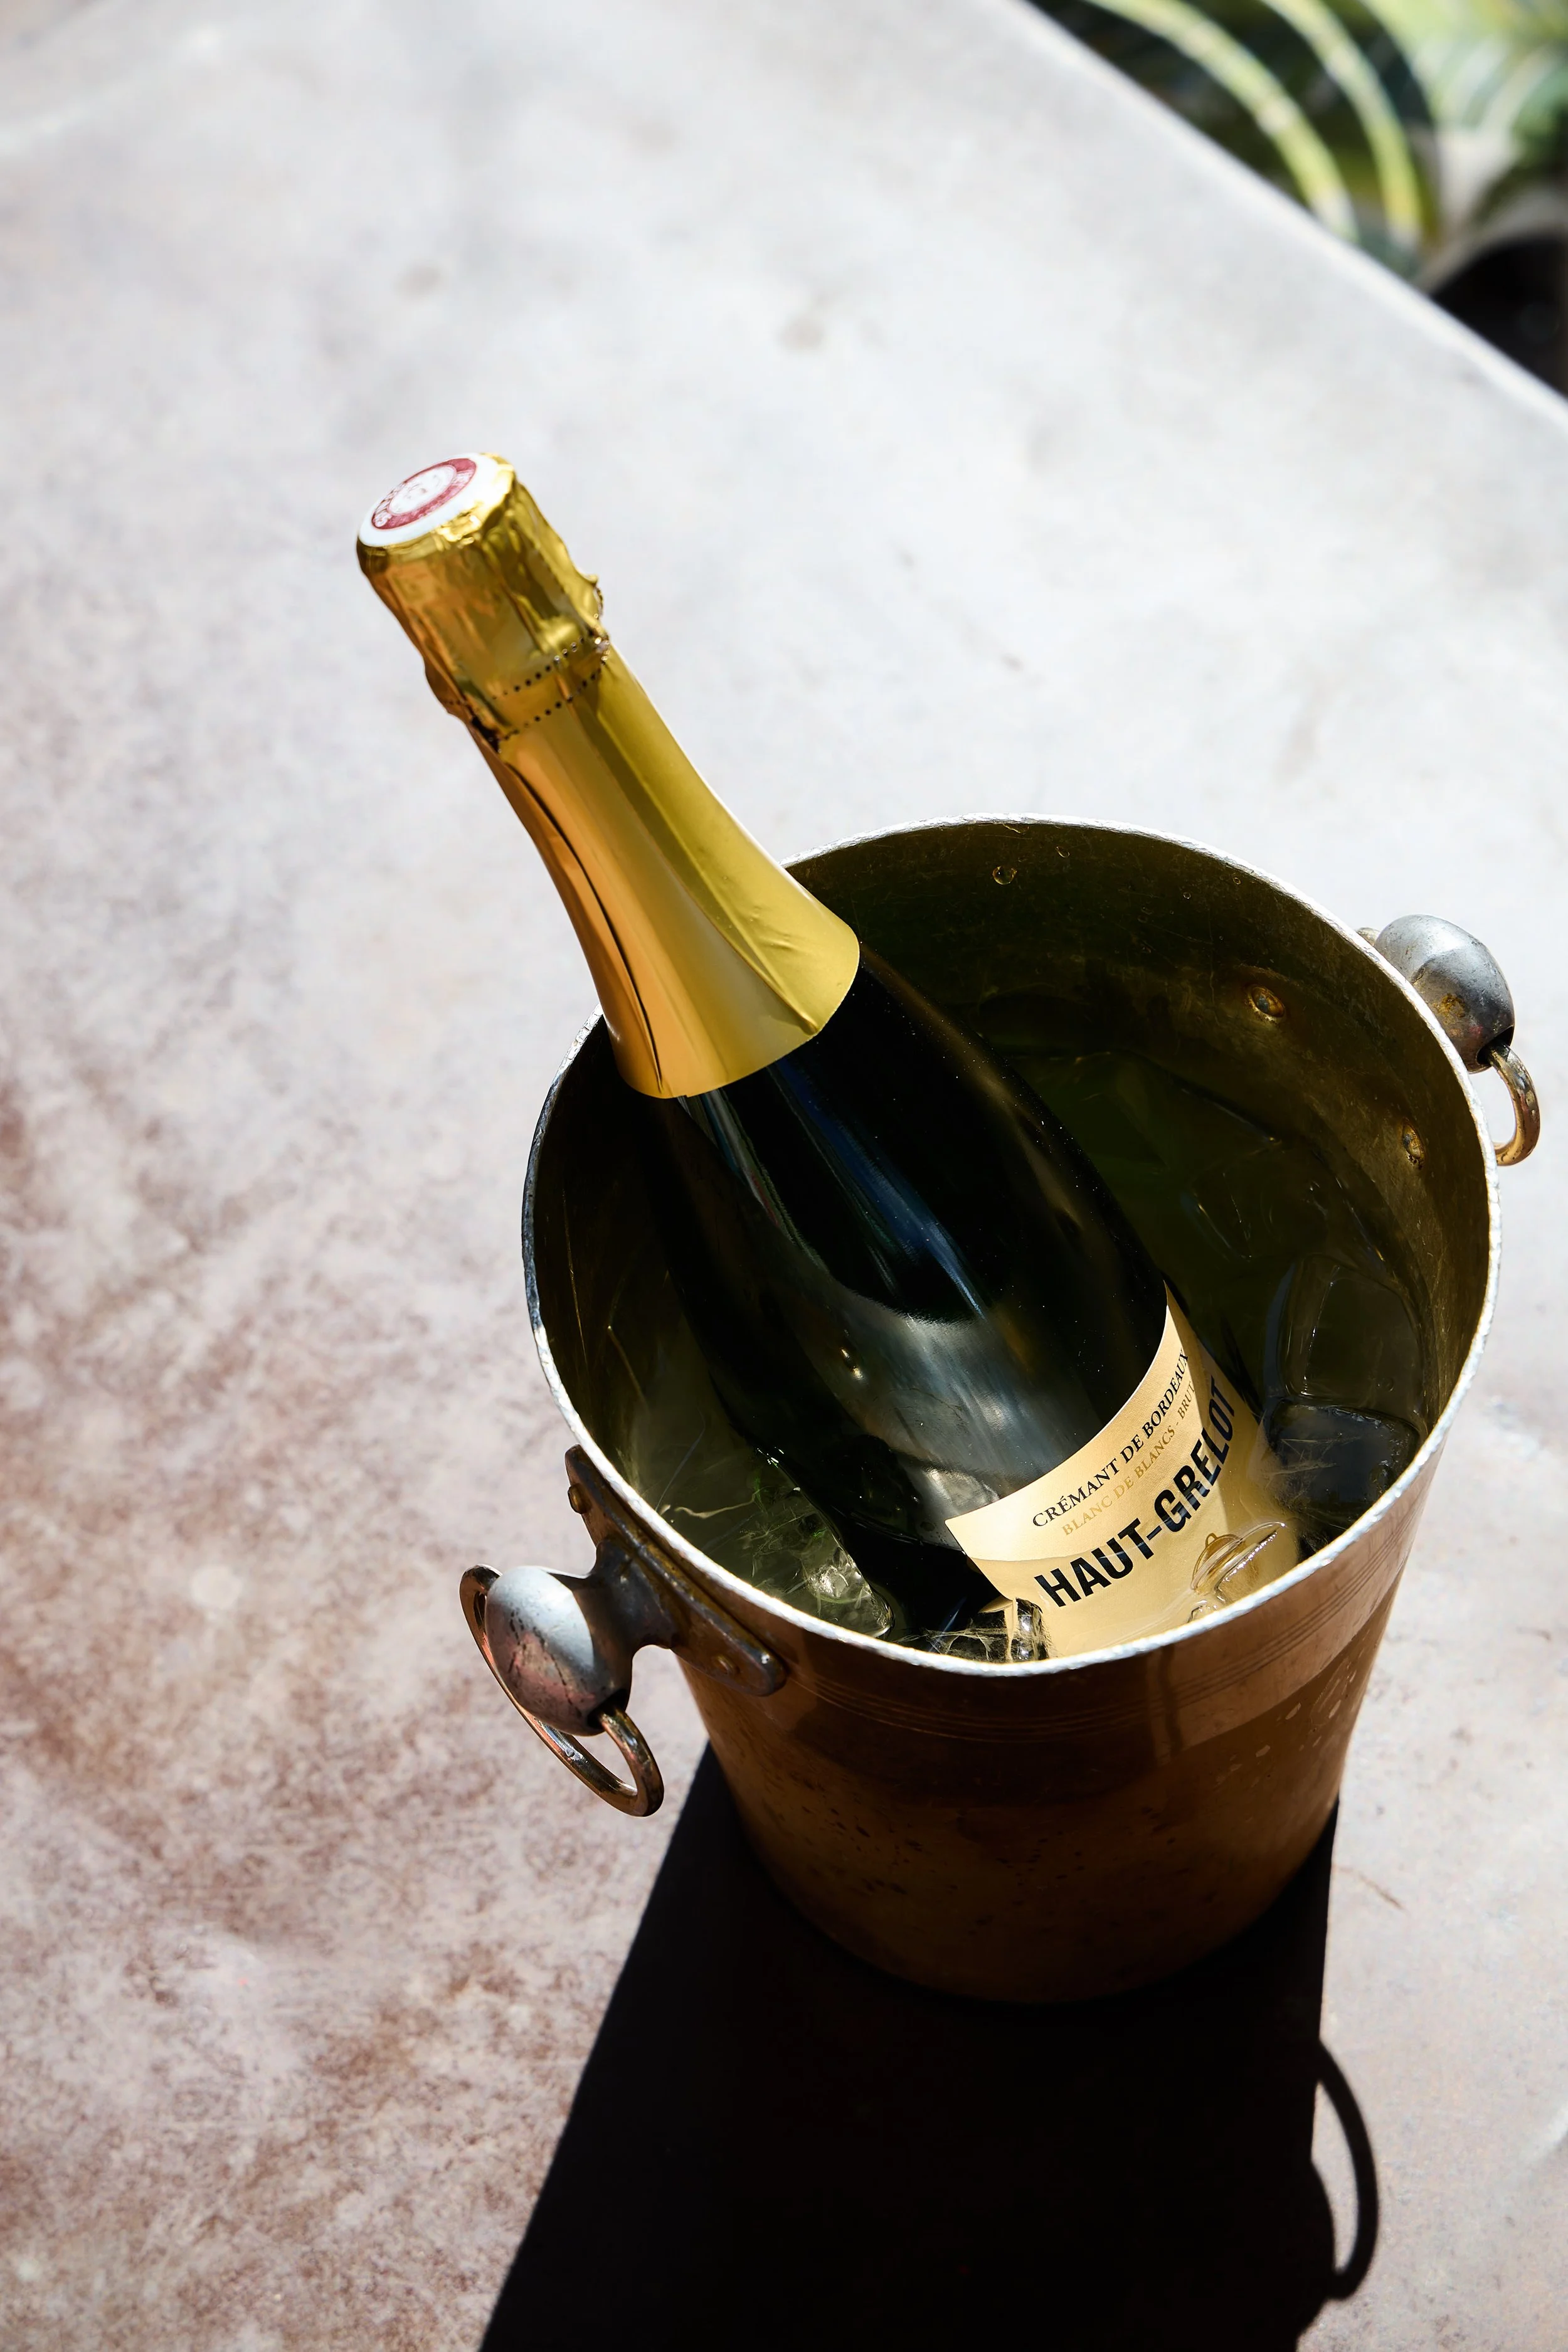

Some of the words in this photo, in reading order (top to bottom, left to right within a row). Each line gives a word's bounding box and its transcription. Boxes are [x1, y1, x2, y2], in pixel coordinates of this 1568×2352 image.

[1032, 1458, 1120, 1527] CRÉMANT
[1120, 1434, 1144, 1464] DE
[1142, 1349, 1189, 1439] BORDEAUX
[1034, 1374, 1234, 1608] HAUT-GRELOT
[1062, 1495, 1113, 1535] BLANC
[1113, 1476, 1134, 1499] DE
[1133, 1425, 1175, 1479] BLANCS
[1177, 1380, 1195, 1420] BRUT
